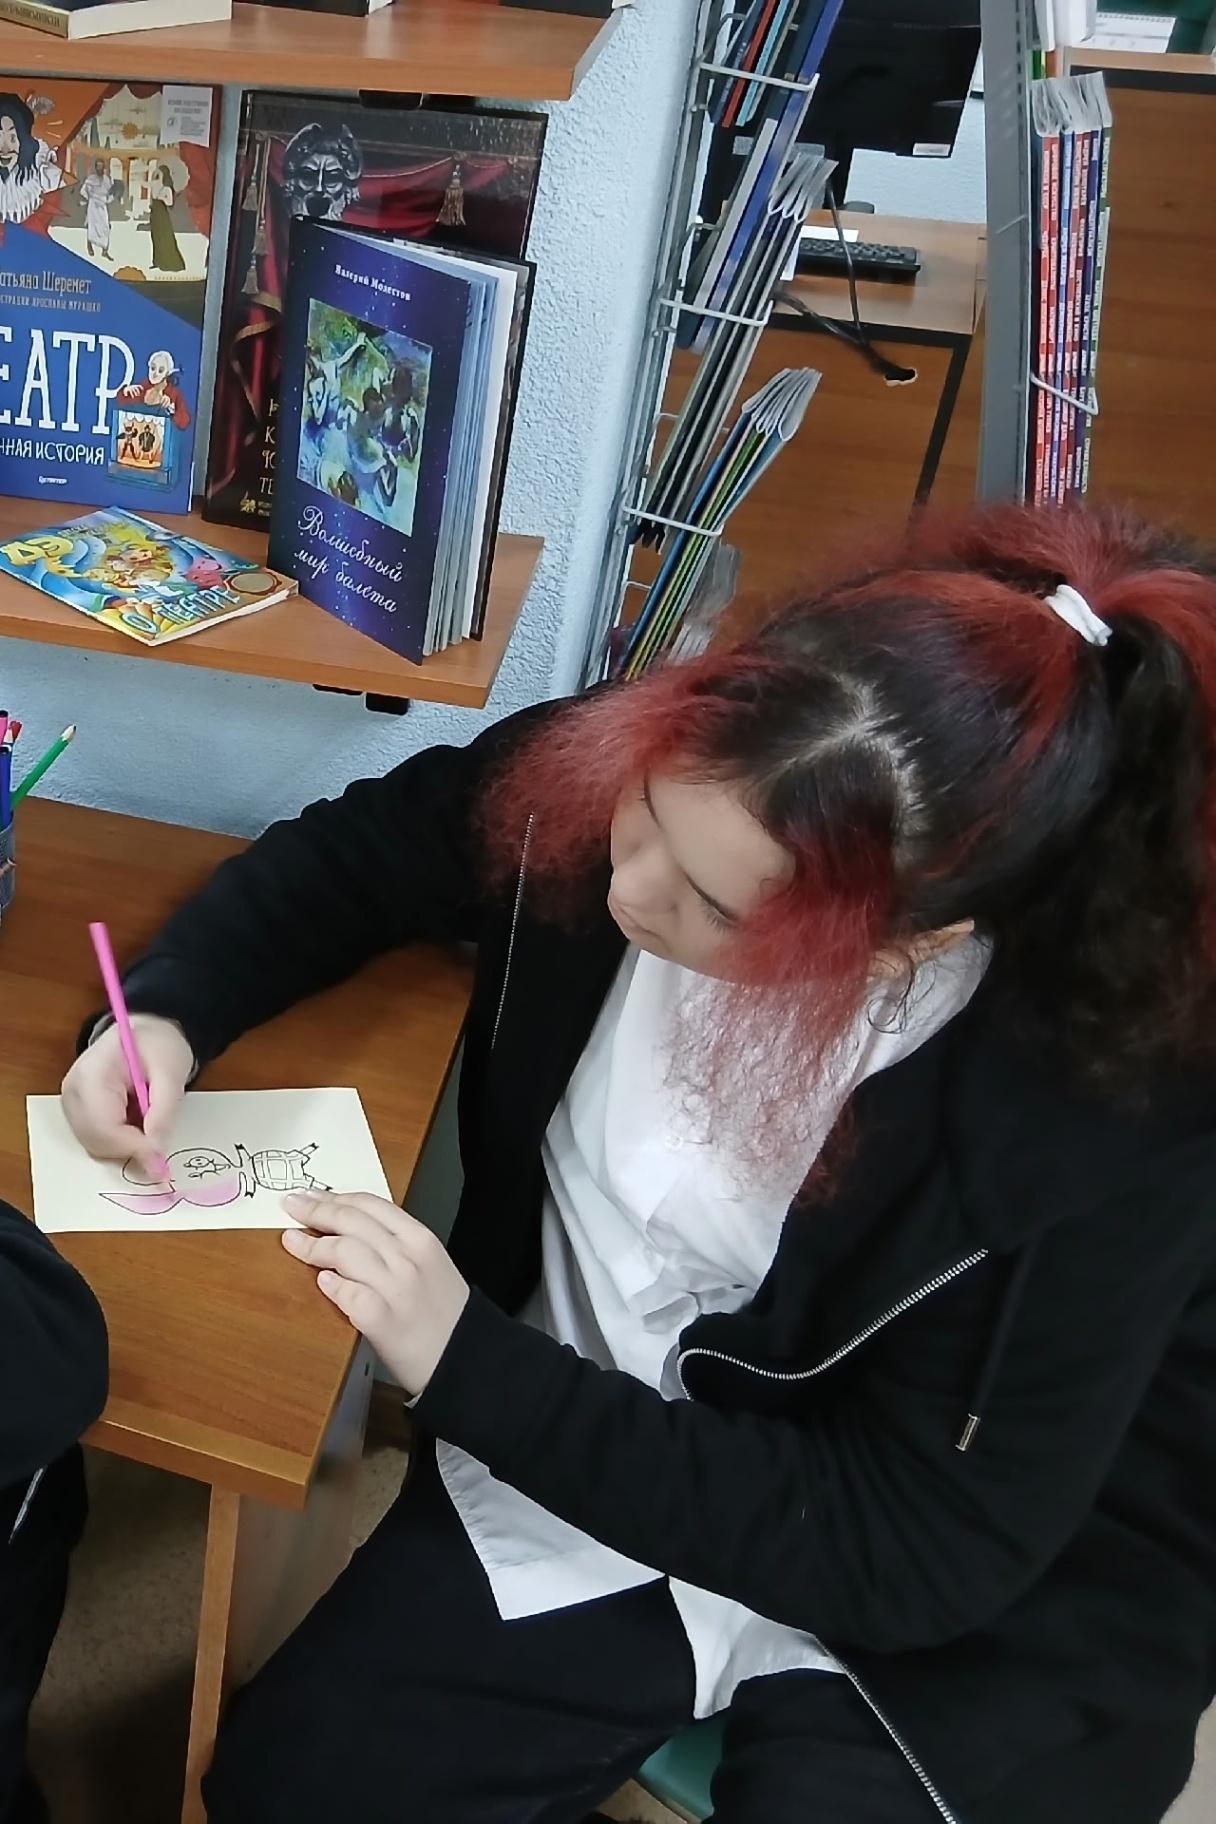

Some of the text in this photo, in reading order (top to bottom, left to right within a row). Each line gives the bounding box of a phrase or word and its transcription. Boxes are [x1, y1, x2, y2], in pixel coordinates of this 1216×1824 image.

[42, 270, 92, 297] Шеремет
[335, 264, 370, 286] Валерий
[35, 442, 105, 466] ИСТОРИЯ
[297, 505, 403, 582] Волшебный
[294, 549, 397, 613] мир балета
[119, 585, 241, 634] О ТЕАТРЕ
